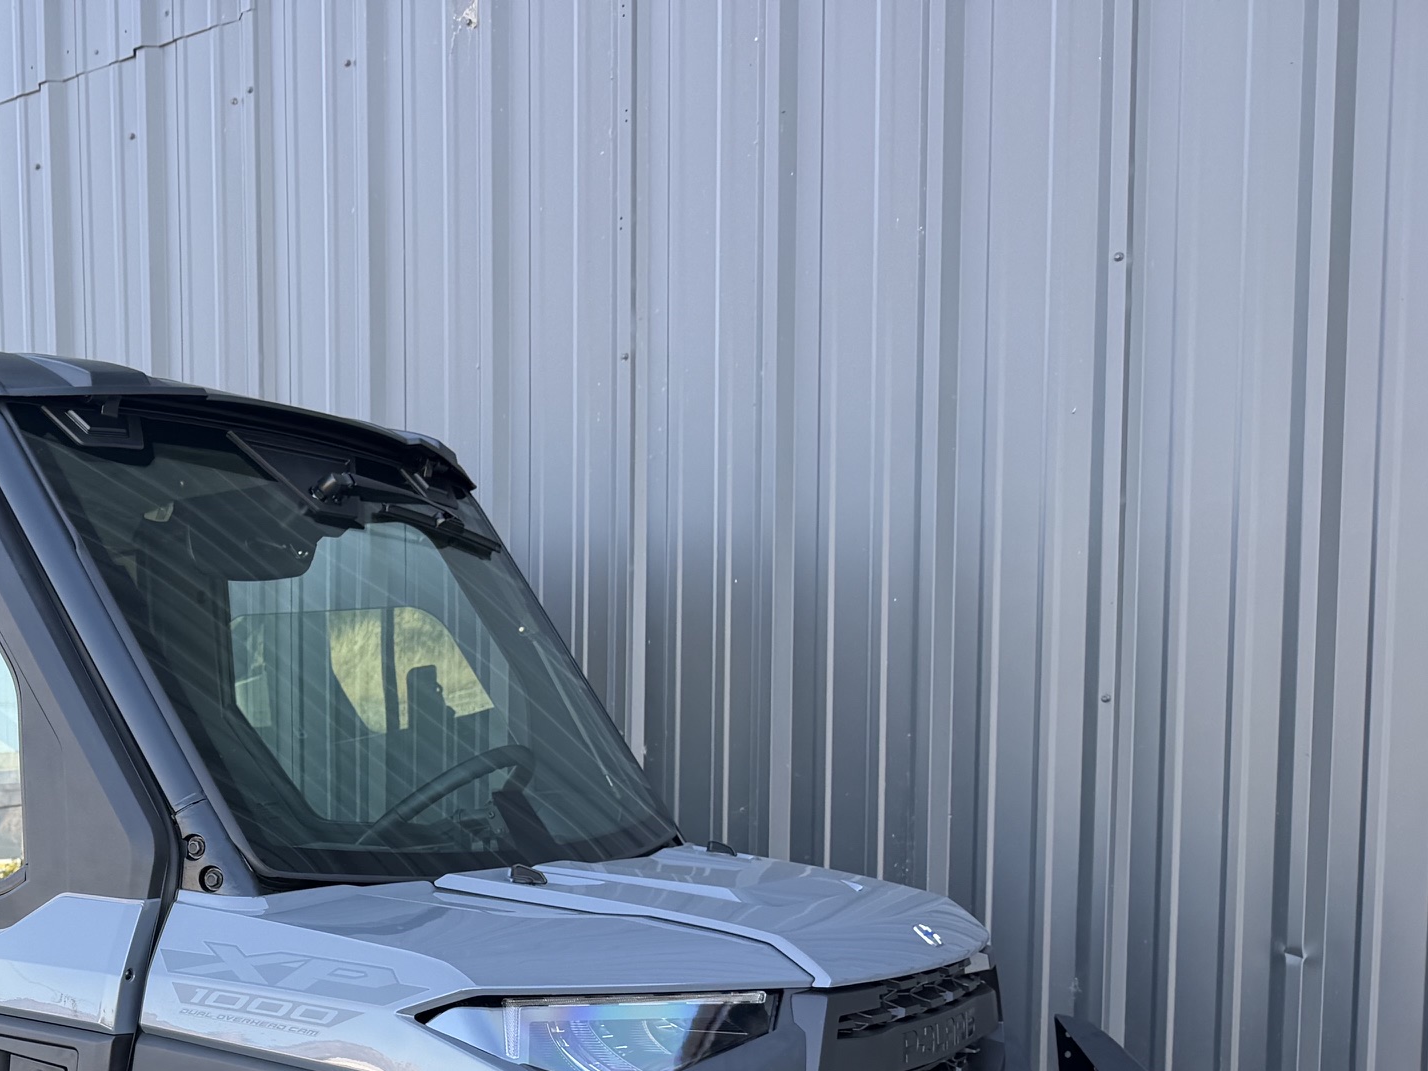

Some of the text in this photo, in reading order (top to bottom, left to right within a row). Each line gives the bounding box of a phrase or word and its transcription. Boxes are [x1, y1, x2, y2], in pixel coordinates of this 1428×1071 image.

[168, 941, 400, 990] XP
[179, 1008, 320, 1037] DUAL OVERHEAD CAM
[188, 987, 338, 1026] 1000
